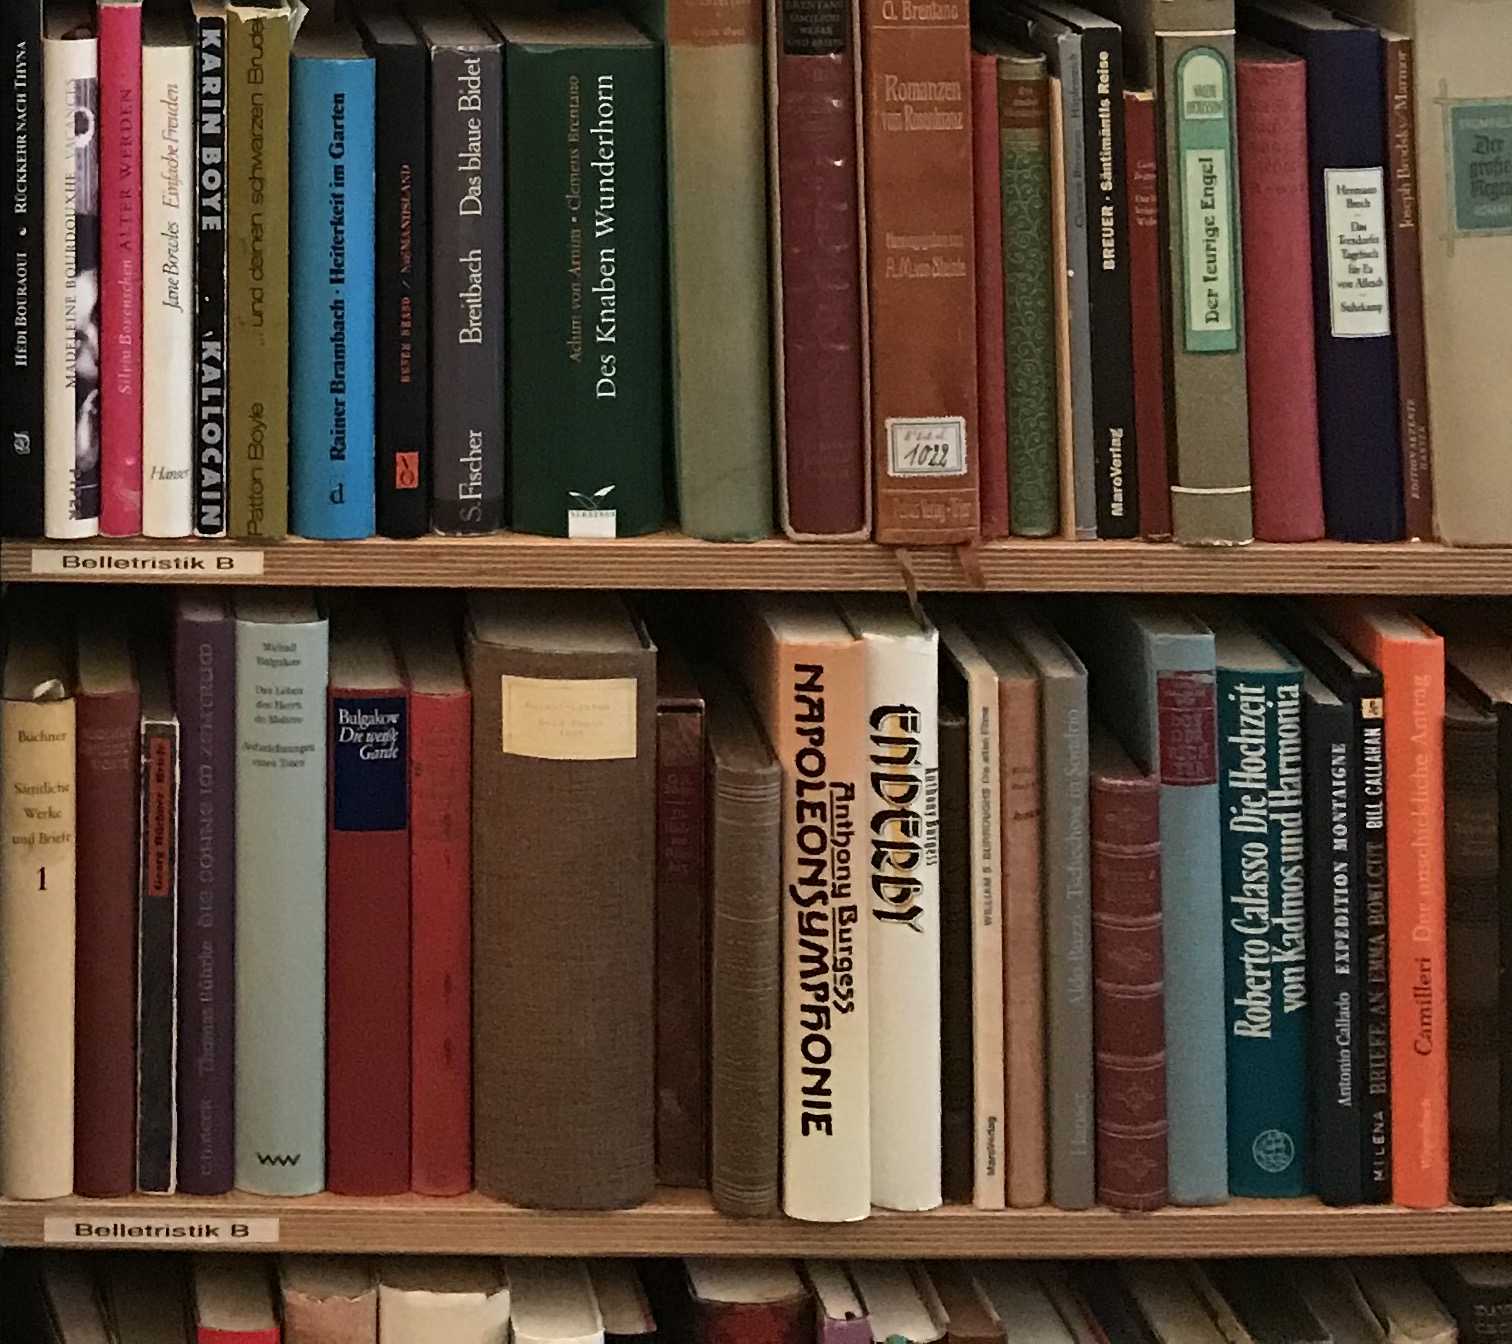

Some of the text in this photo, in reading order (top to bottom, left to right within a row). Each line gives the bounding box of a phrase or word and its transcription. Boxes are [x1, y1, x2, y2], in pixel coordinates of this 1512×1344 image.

[459, 57, 481, 112] Bidet
[461, 119, 482, 171] blaue
[461, 176, 481, 216] Das
[592, 74, 617, 399] Des Knaben Wunderhorn
[328, 93, 348, 461] Rainer Brambach Heiterkeit im Garten
[460, 249, 483, 345] Breitbach
[460, 429, 483, 500] Fischer
[62, 554, 234, 569] Belletristik B
[1228, 684, 1272, 1039] Roberto Calasso Die Hochzeit
[1270, 684, 1307, 1013] von Kadmos und Harmonia
[789, 663, 832, 1137] NAPOLEONSYMPHONIE
[831, 781, 858, 1014] Anthony Burgess
[75, 1224, 249, 1238] Belletristik B
